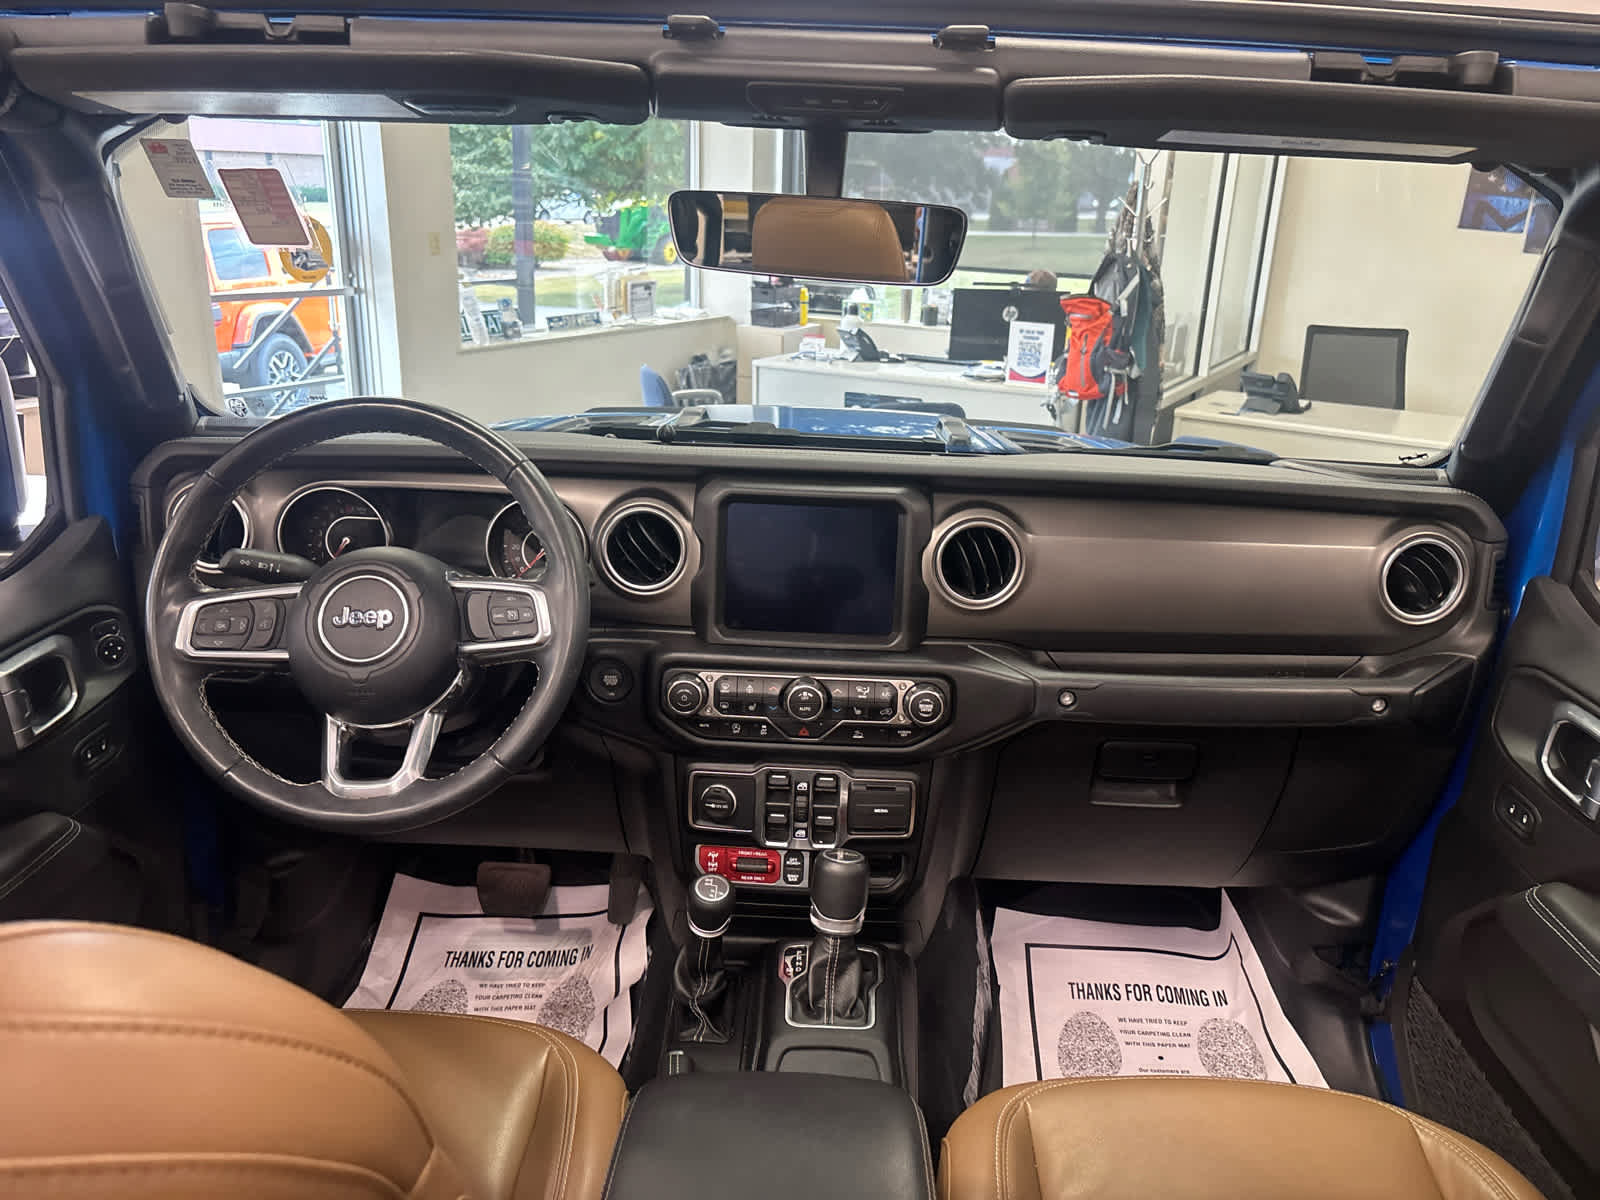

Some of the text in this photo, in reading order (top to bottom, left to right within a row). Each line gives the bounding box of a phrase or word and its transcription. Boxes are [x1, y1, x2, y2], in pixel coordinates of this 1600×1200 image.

[332, 606, 394, 631] Jeep
[445, 944, 594, 969] THANKS FOR COMING IN
[491, 993, 523, 1001] CARPETING
[1067, 982, 1229, 1008] THANKS FOR COMING IN
